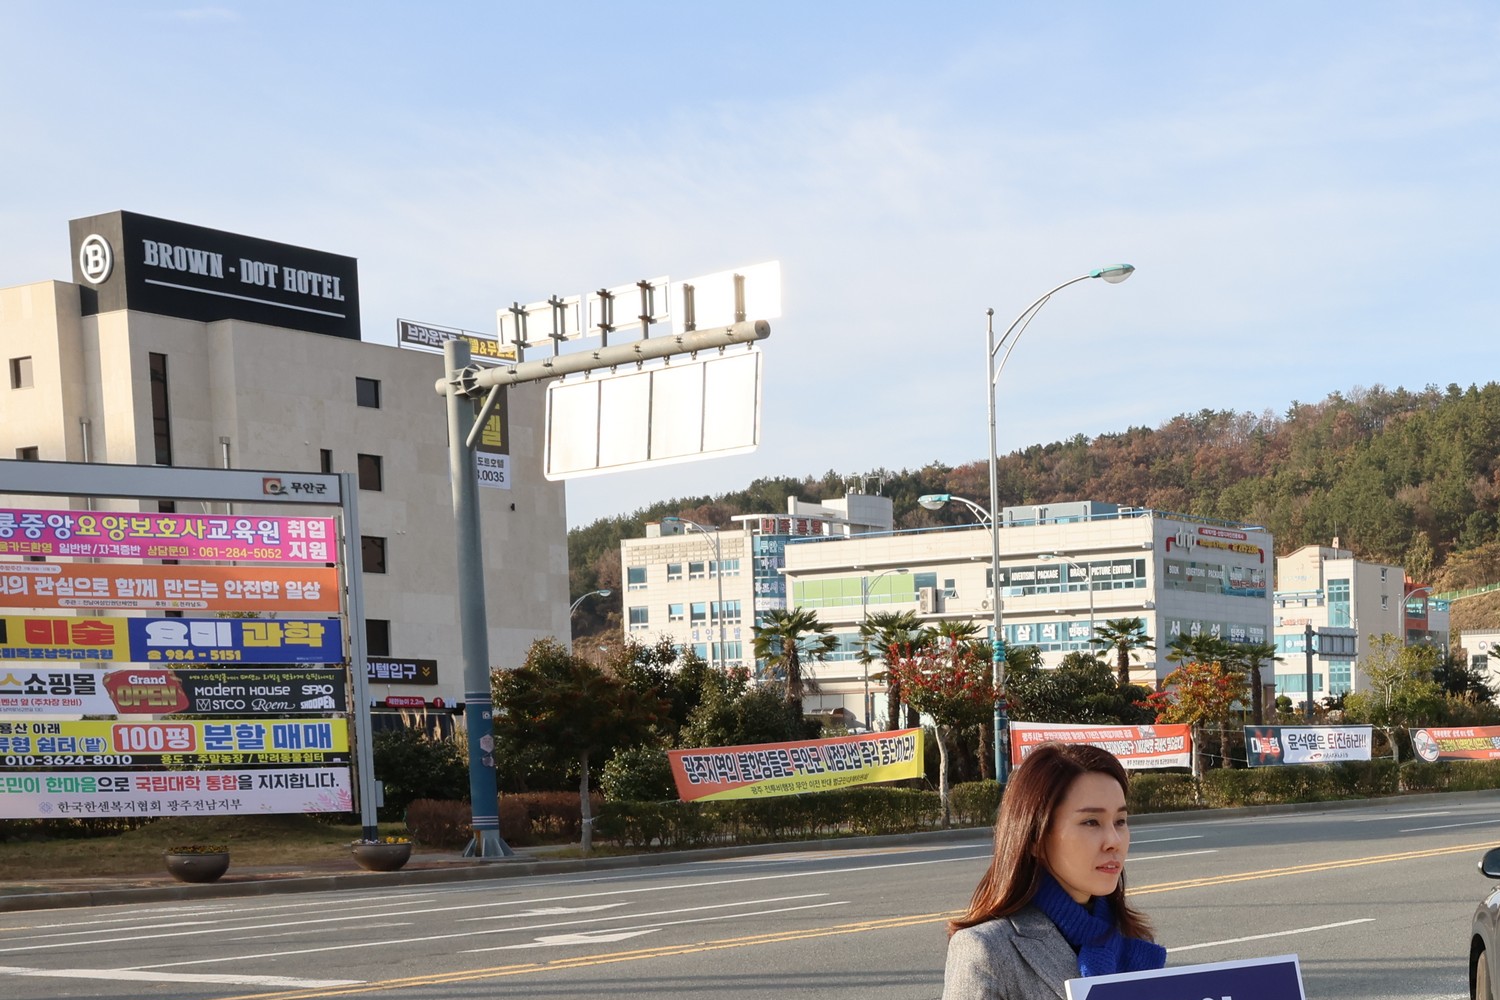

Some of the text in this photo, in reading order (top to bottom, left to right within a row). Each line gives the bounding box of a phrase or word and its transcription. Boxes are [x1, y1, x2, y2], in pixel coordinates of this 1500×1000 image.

[142, 239, 224, 279] BROWN
[239, 258, 279, 288] DOT
[282, 267, 345, 301] HOTEL
[291, 482, 327, 494] 무안군
[287, 520, 326, 539] 취업
[148, 545, 189, 558] 상담문의
[199, 546, 282, 559] 061-284-5052
[289, 541, 327, 560] 지원
[1037, 569, 1058, 579] PACKAGE
[1092, 566, 1111, 576] PICTURE
[1113, 565, 1131, 574] EDITING
[34, 577, 110, 597] 관심으로
[115, 578, 158, 598] 함께
[163, 579, 219, 599] 만드는
[224, 580, 280, 599] 안전한
[285, 581, 321, 600] 일상
[242, 621, 325, 647] 과학
[0, 648, 113, 660] 미목포남악교육원
[166, 650, 195, 660] 984
[210, 650, 242, 660] 5151
[128, 675, 167, 685] Grand
[116, 685, 177, 707] OPEN
[194, 683, 334, 696] Modern House SPAO
[212, 699, 246, 710] STCO
[251, 698, 295, 711] Roem
[33, 723, 61, 734] 아래
[119, 727, 190, 750] 100평
[204, 724, 266, 750] 분할
[272, 723, 332, 749] 매매
[1288, 733, 1367, 751] 윤석열은 퇴진하라!!
[5, 755, 132, 766] 010-3624-8010
[161, 754, 184, 764] 용도
[197, 753, 244, 763] 주말농장
[790, 747, 825, 775] 무안군
[820, 742, 863, 771] 내정간섭
[859, 741, 880, 768] 즉각
[879, 736, 915, 765] 중단하라!
[45, 777, 130, 793] 한마음으로
[135, 775, 200, 792] 국립대학
[206, 774, 253, 791] 통합을
[258, 773, 339, 790] 지지합니다.
[751, 786, 763, 795] 광주
[764, 782, 795, 793] 전투비행장
[795, 781, 808, 790] 무안
[809, 779, 820, 788] 이전
[821, 778, 832, 787] 반대
[58, 799, 243, 814] 한국한센복지협회 광주전남지부
